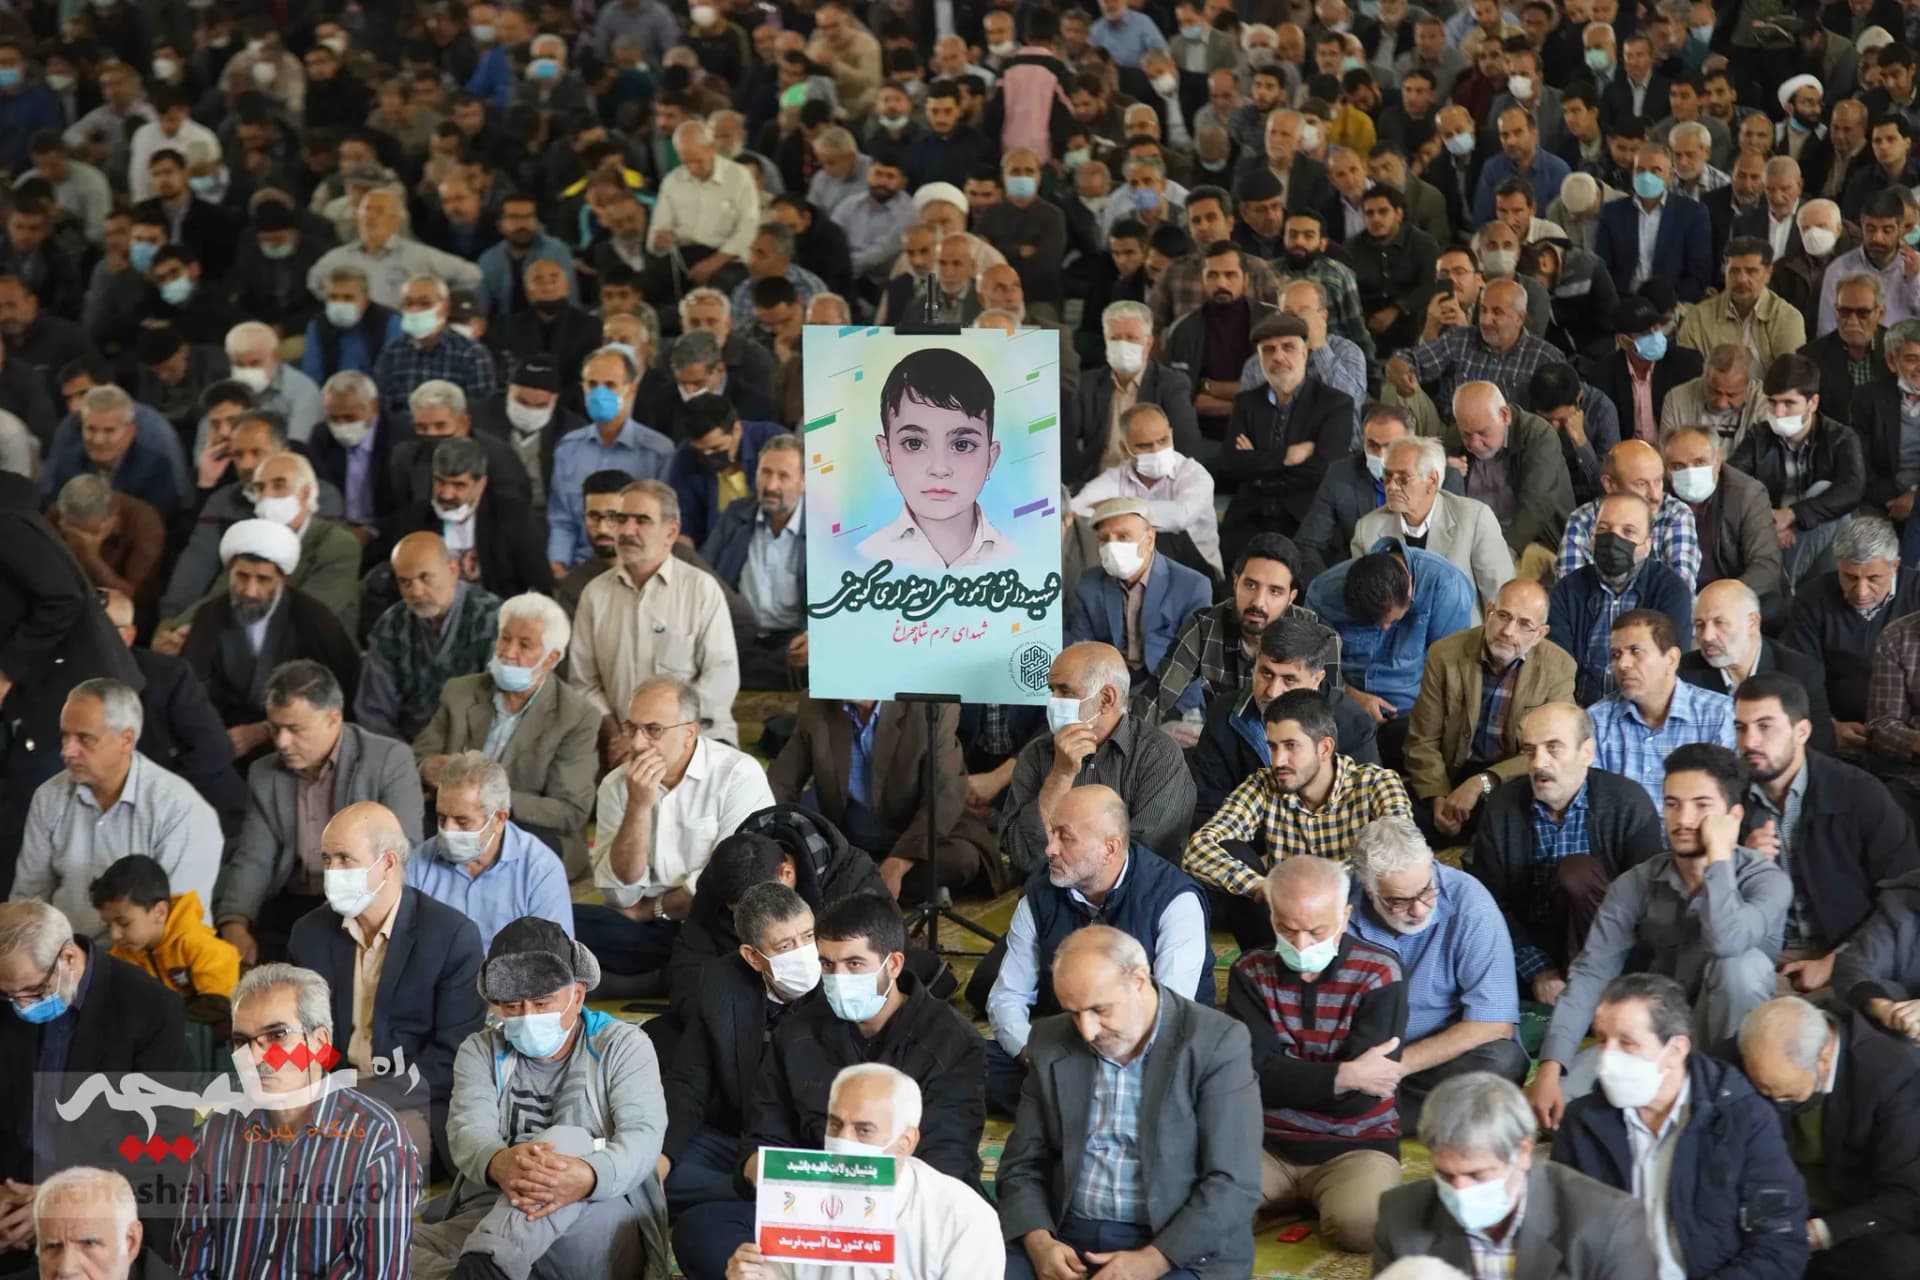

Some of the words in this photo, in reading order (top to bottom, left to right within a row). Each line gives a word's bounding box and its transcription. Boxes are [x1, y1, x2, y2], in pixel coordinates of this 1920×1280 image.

[873, 584, 902, 605] لری
[900, 579, 933, 604] اصغر
[905, 579, 957, 617] علی
[958, 577, 993, 602] آموز
[991, 574, 1026, 608] دانش
[1024, 577, 1059, 616] شهید
[929, 626, 951, 648] حرم
[952, 620, 989, 643] شهدای
[812, 1160, 830, 1174] فقیه
[829, 1163, 850, 1177] ولایت
[779, 1235, 802, 1249] نرسد
[802, 1235, 827, 1250] آسیب
[827, 1238, 842, 1249] شما
[841, 1239, 865, 1253] کشور
